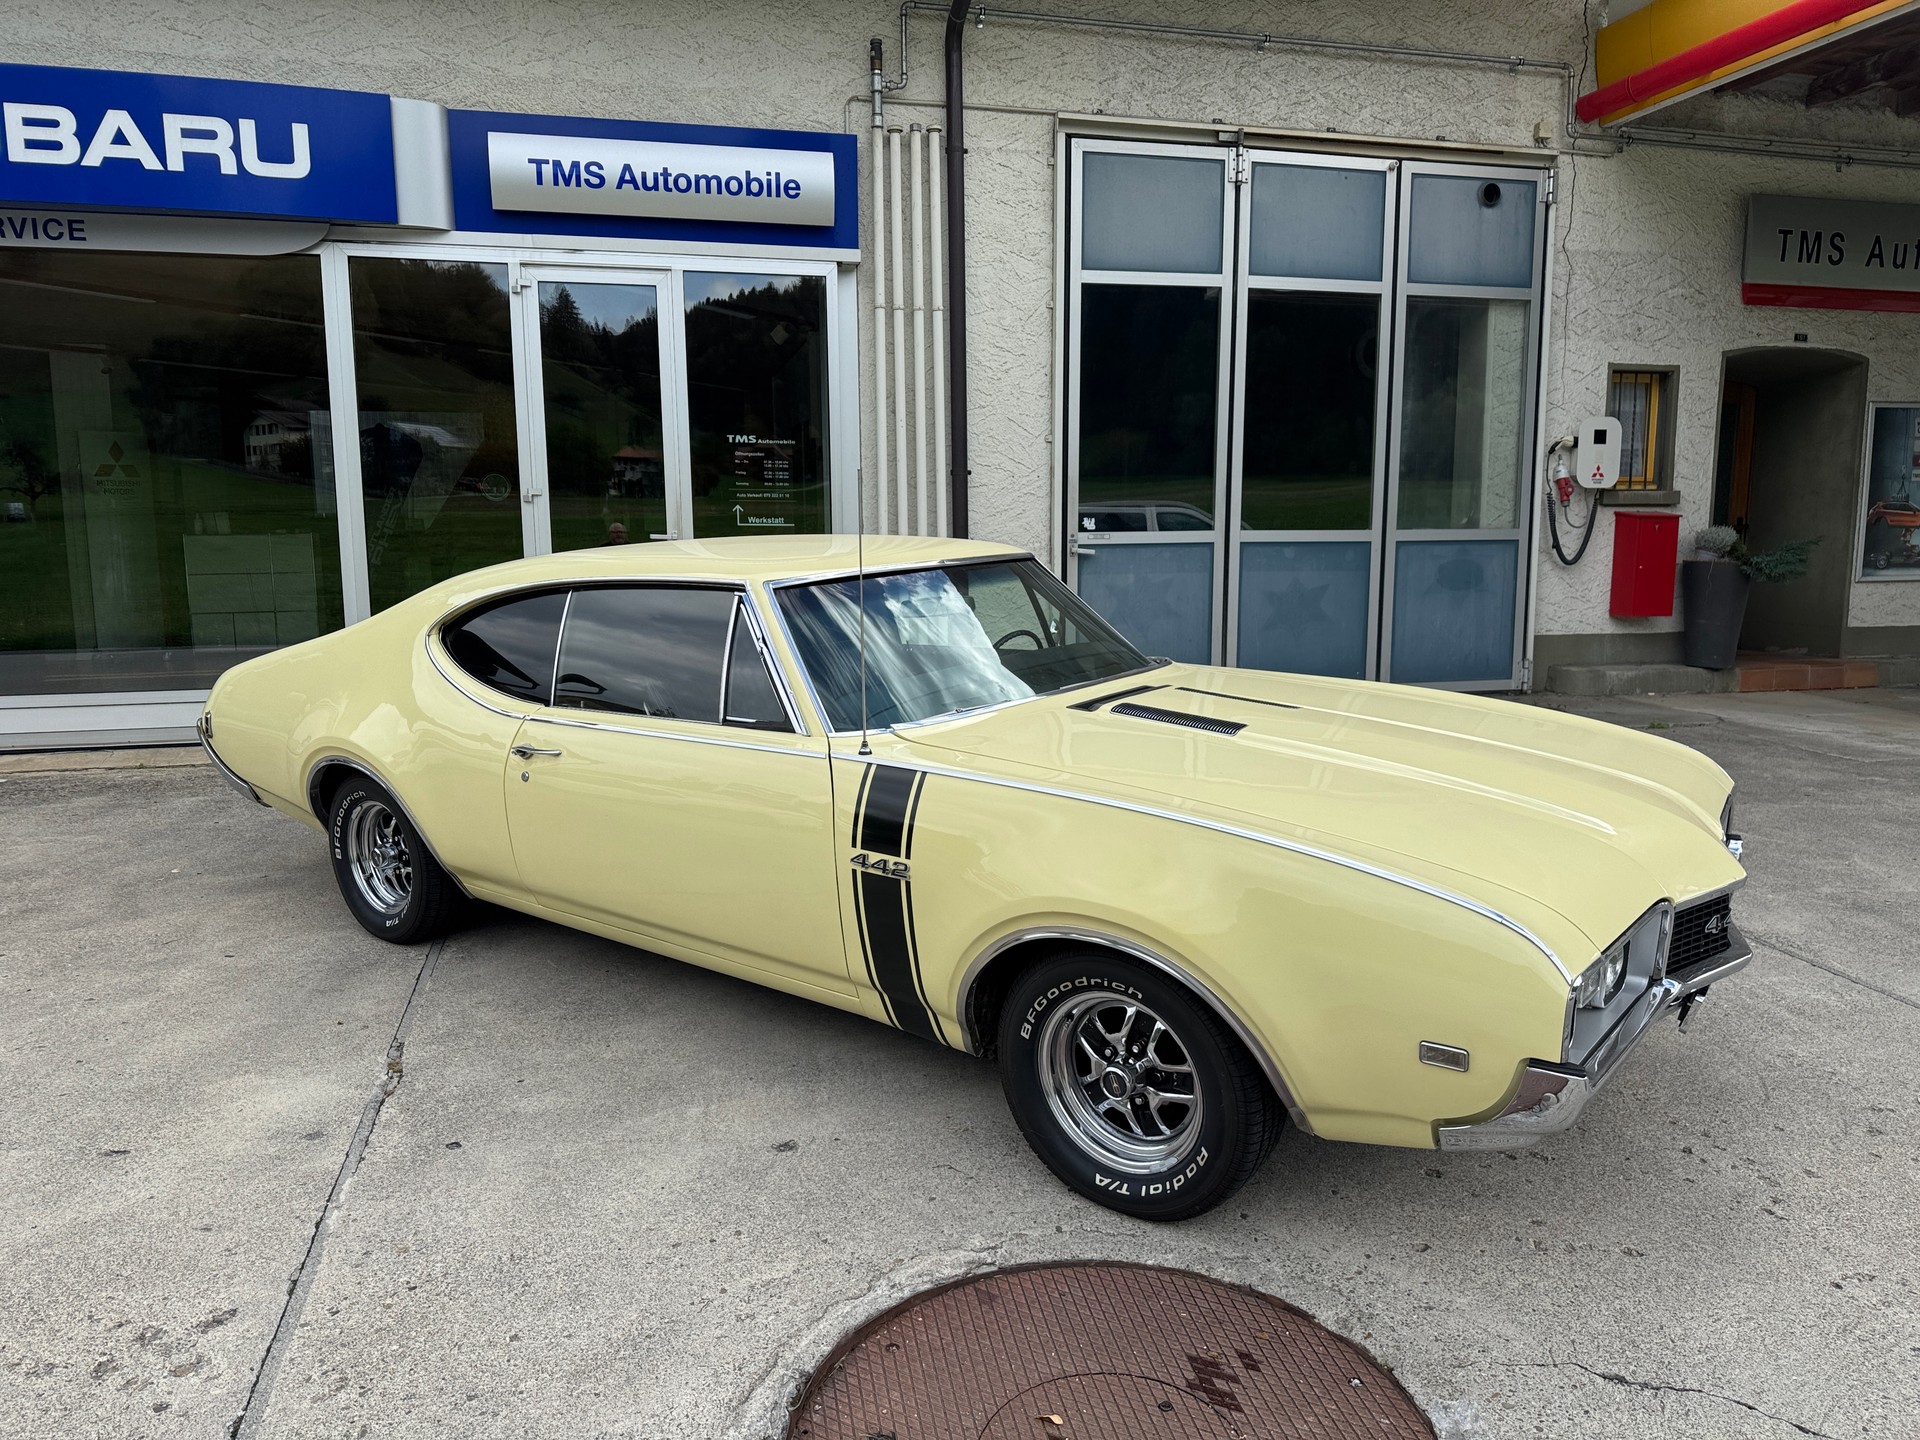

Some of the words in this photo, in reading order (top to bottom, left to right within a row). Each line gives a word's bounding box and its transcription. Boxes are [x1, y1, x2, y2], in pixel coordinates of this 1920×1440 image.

[3, 102, 311, 179] BARU
[527, 157, 606, 189] TMS
[615, 163, 801, 199] Automobile
[1777, 228, 1845, 266] TMS
[726, 434, 757, 444] TMS
[103, 487, 136, 496] MOTORS
[747, 516, 785, 524] Werkstatt
[334, 790, 367, 860] BFGoodrich
[850, 853, 911, 880] 442
[1020, 976, 1143, 1040] BFGoodrich
[1094, 1172, 1131, 1196] T/A
[1140, 1146, 1209, 1197] Radial
